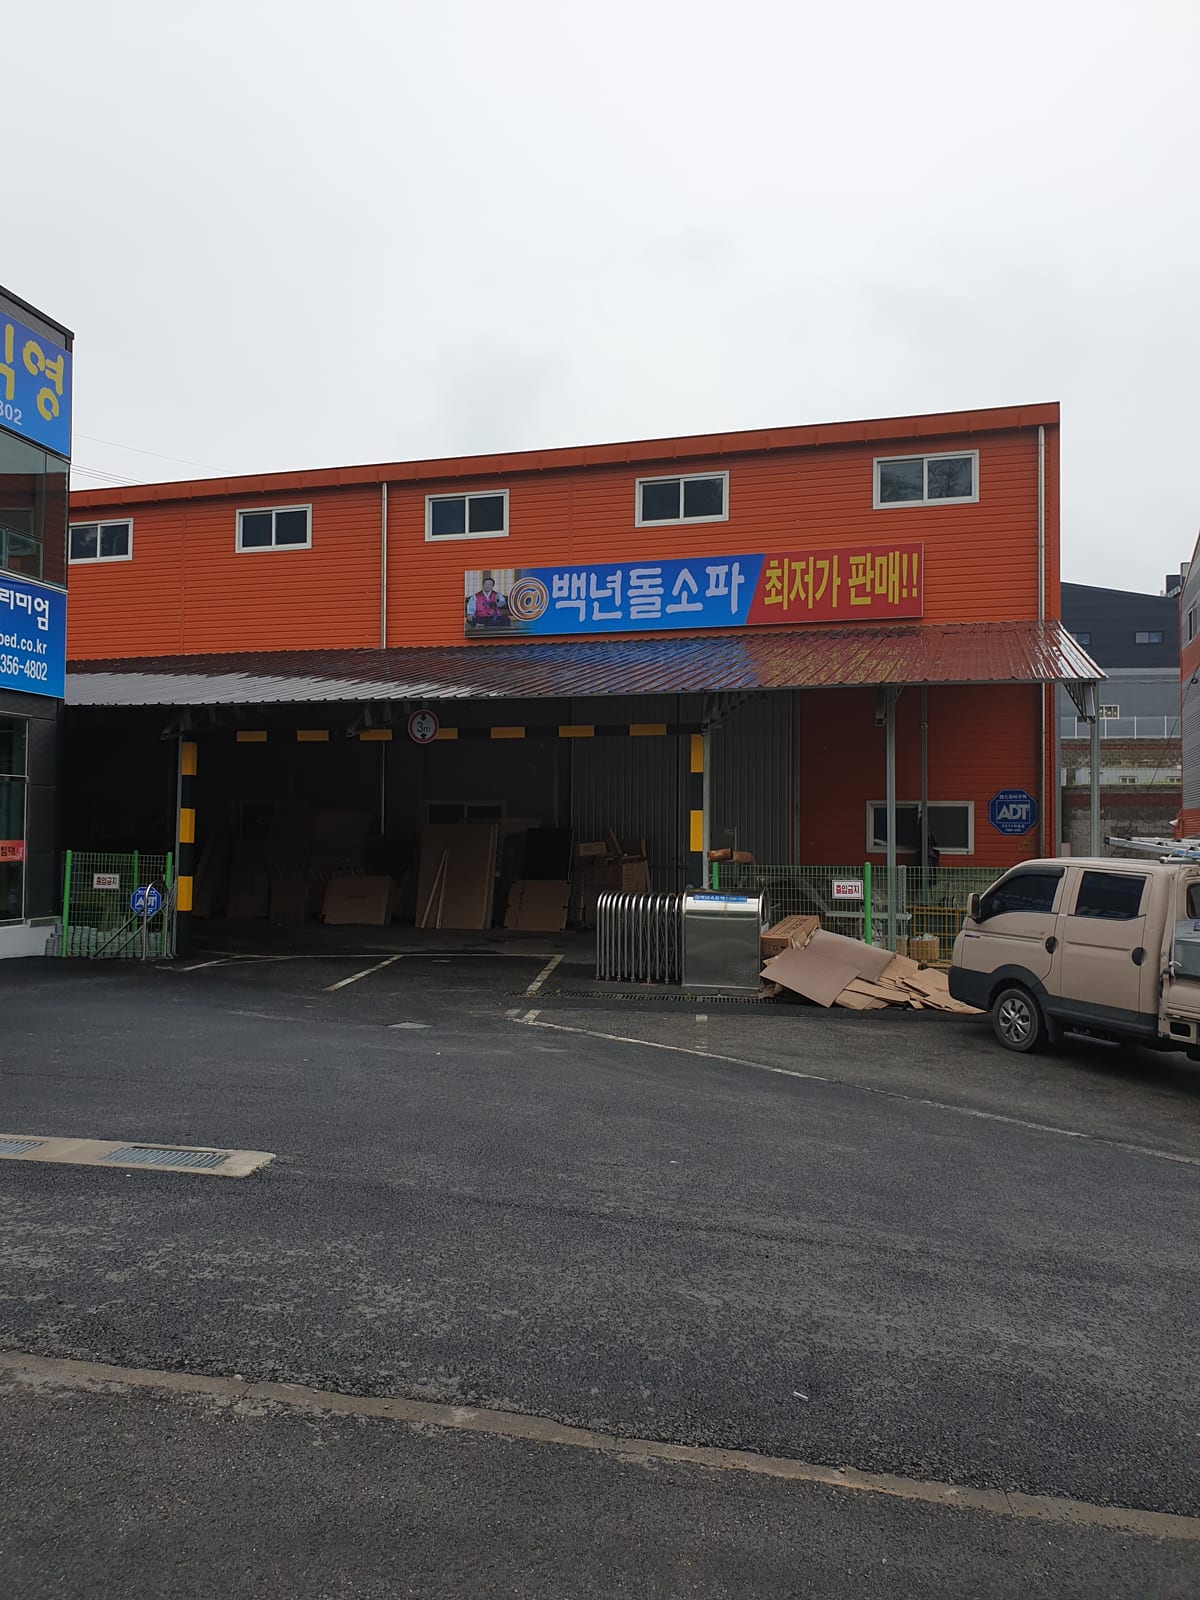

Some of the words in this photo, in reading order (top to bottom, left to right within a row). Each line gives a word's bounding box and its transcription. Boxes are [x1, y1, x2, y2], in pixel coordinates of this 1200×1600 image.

[552, 562, 745, 622] 백년돌소파
[764, 555, 841, 611] 최저가
[848, 550, 919, 606] 판매!!
[416, 721, 430, 733] 3m
[996, 803, 1030, 820] ADT
[836, 885, 860, 894] 출입금지
